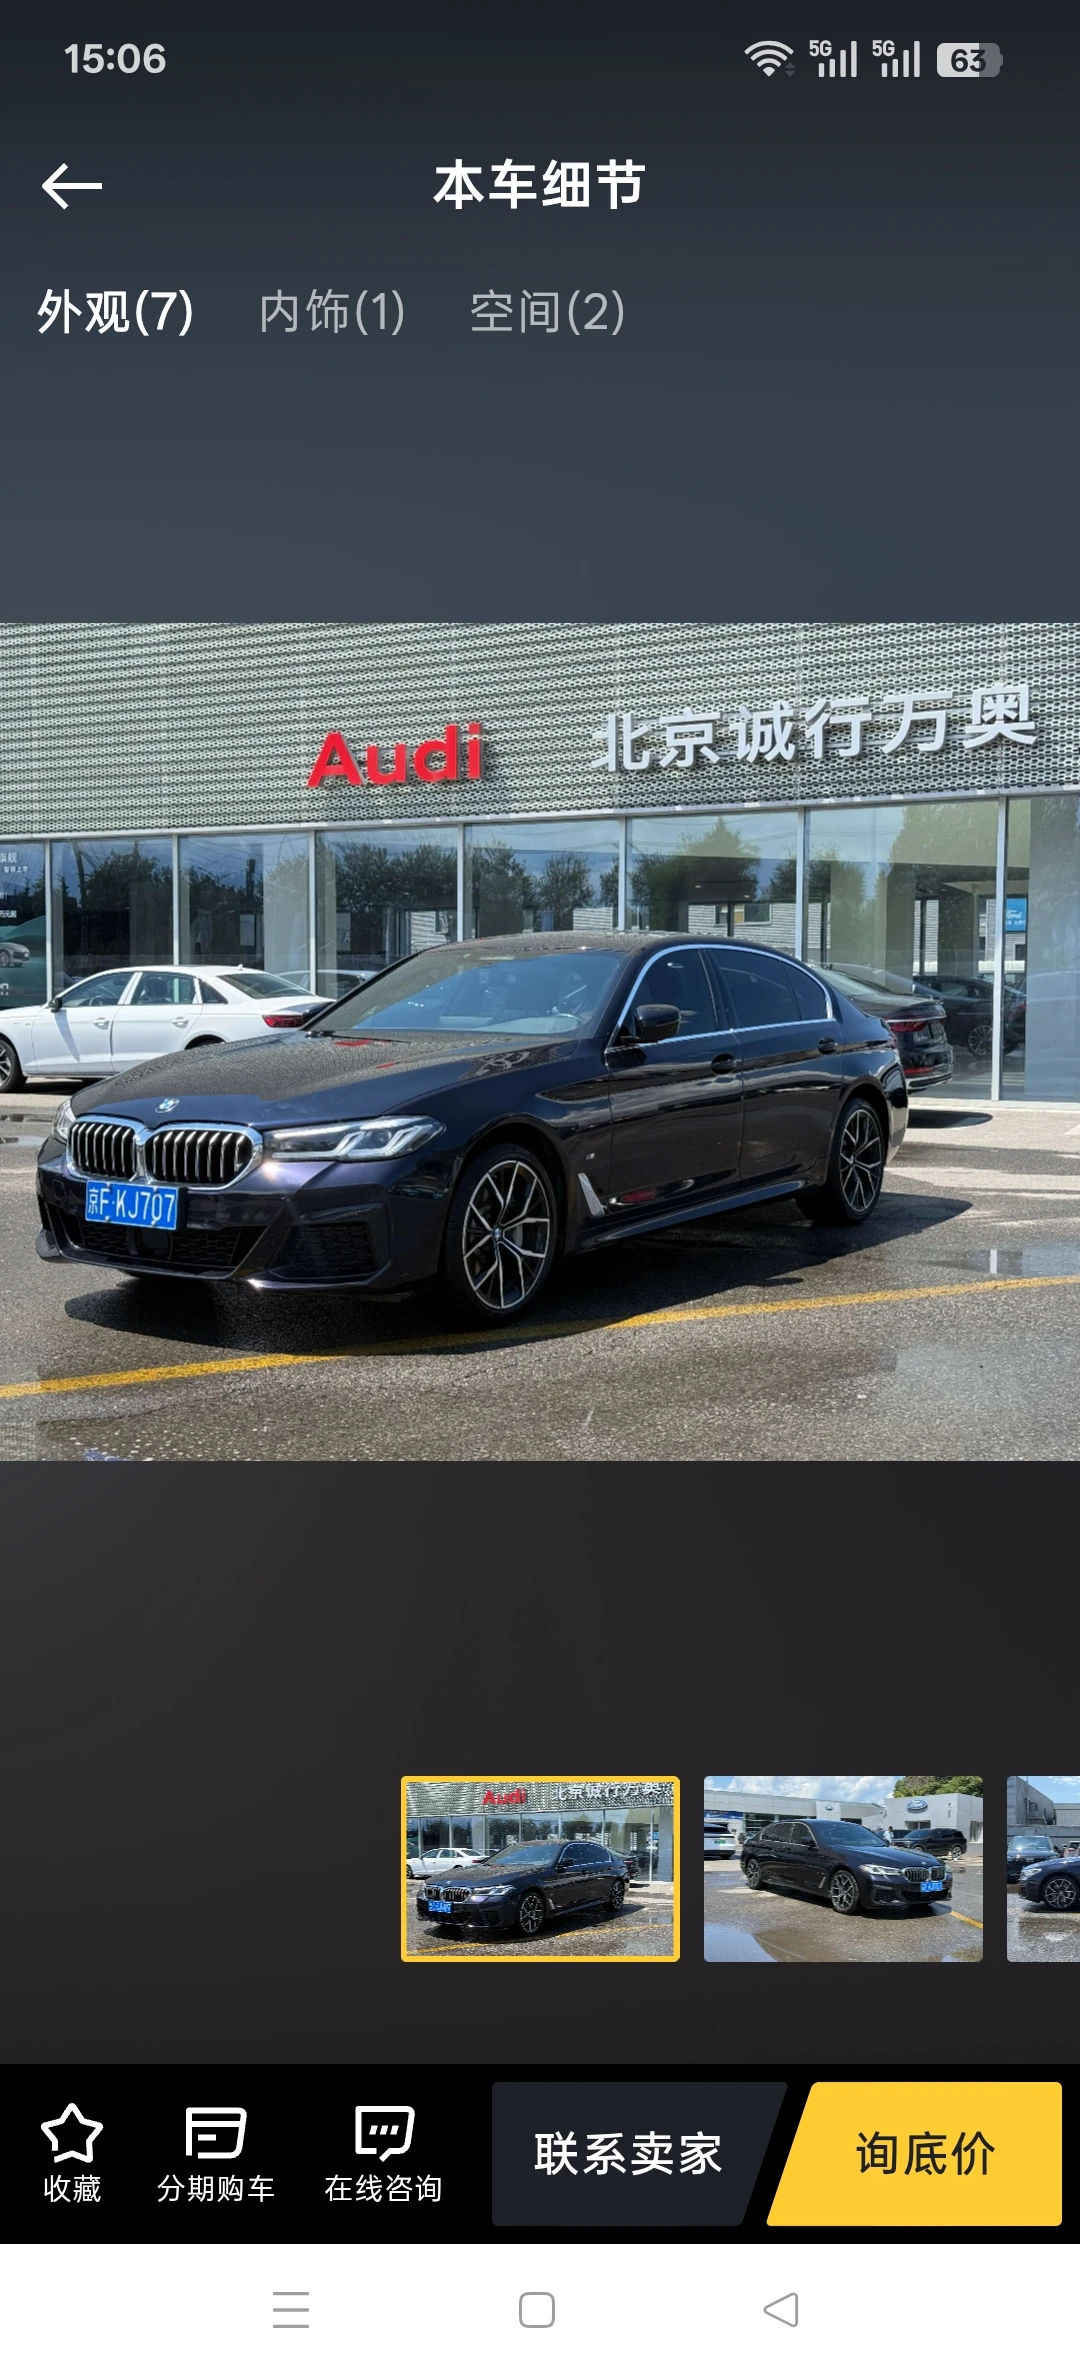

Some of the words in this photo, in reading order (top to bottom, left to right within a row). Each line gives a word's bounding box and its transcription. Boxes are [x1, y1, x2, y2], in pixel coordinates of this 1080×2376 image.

[64, 43, 166, 74] 15:06
[809, 39, 833, 57] 5G
[872, 39, 896, 57] 5G
[950, 49, 987, 73] 63
[432, 157, 646, 210] 本车细节
[36, 288, 193, 337] 外观(7)
[260, 288, 405, 336] 内饰(1)
[470, 288, 625, 336] 空间(2)
[592, 683, 1038, 773] 北京诚行万奥
[306, 722, 484, 788] Audi
[482, 1788, 526, 1805] Audi
[534, 2130, 723, 2176] 联系卖家
[856, 2130, 996, 2176] 询底价
[43, 2174, 102, 2204] 收藏
[157, 2174, 275, 2203] 分期购车
[324, 2173, 442, 2203] 在线咨询
